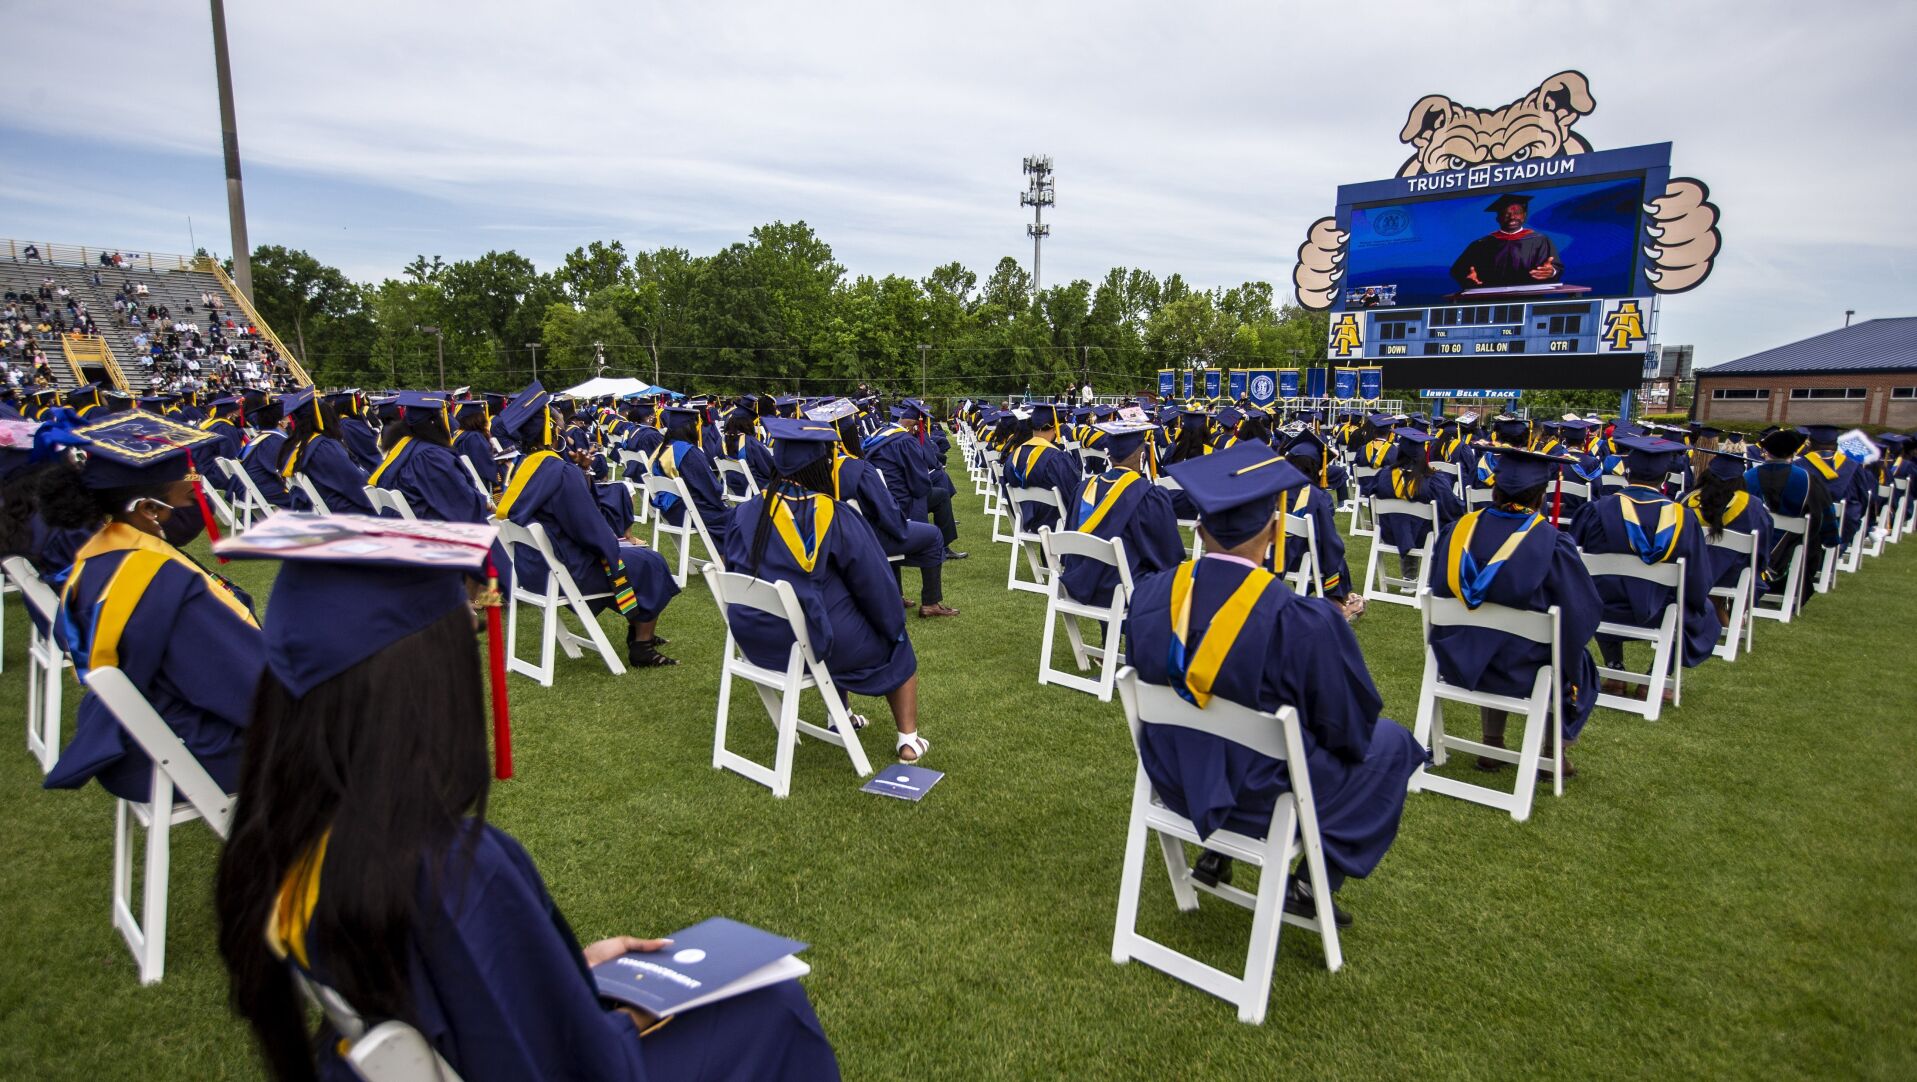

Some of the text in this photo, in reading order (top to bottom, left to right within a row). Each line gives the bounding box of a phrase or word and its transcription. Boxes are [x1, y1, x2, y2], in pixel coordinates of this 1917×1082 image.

[1407, 172, 1466, 192] TRUIST
[1494, 158, 1575, 181] STADIUM
[1387, 345, 1407, 355] DOWN
[1441, 343, 1461, 353] TO GO
[1475, 342, 1508, 353] BALL ON
[1550, 340, 1568, 351] QTR
